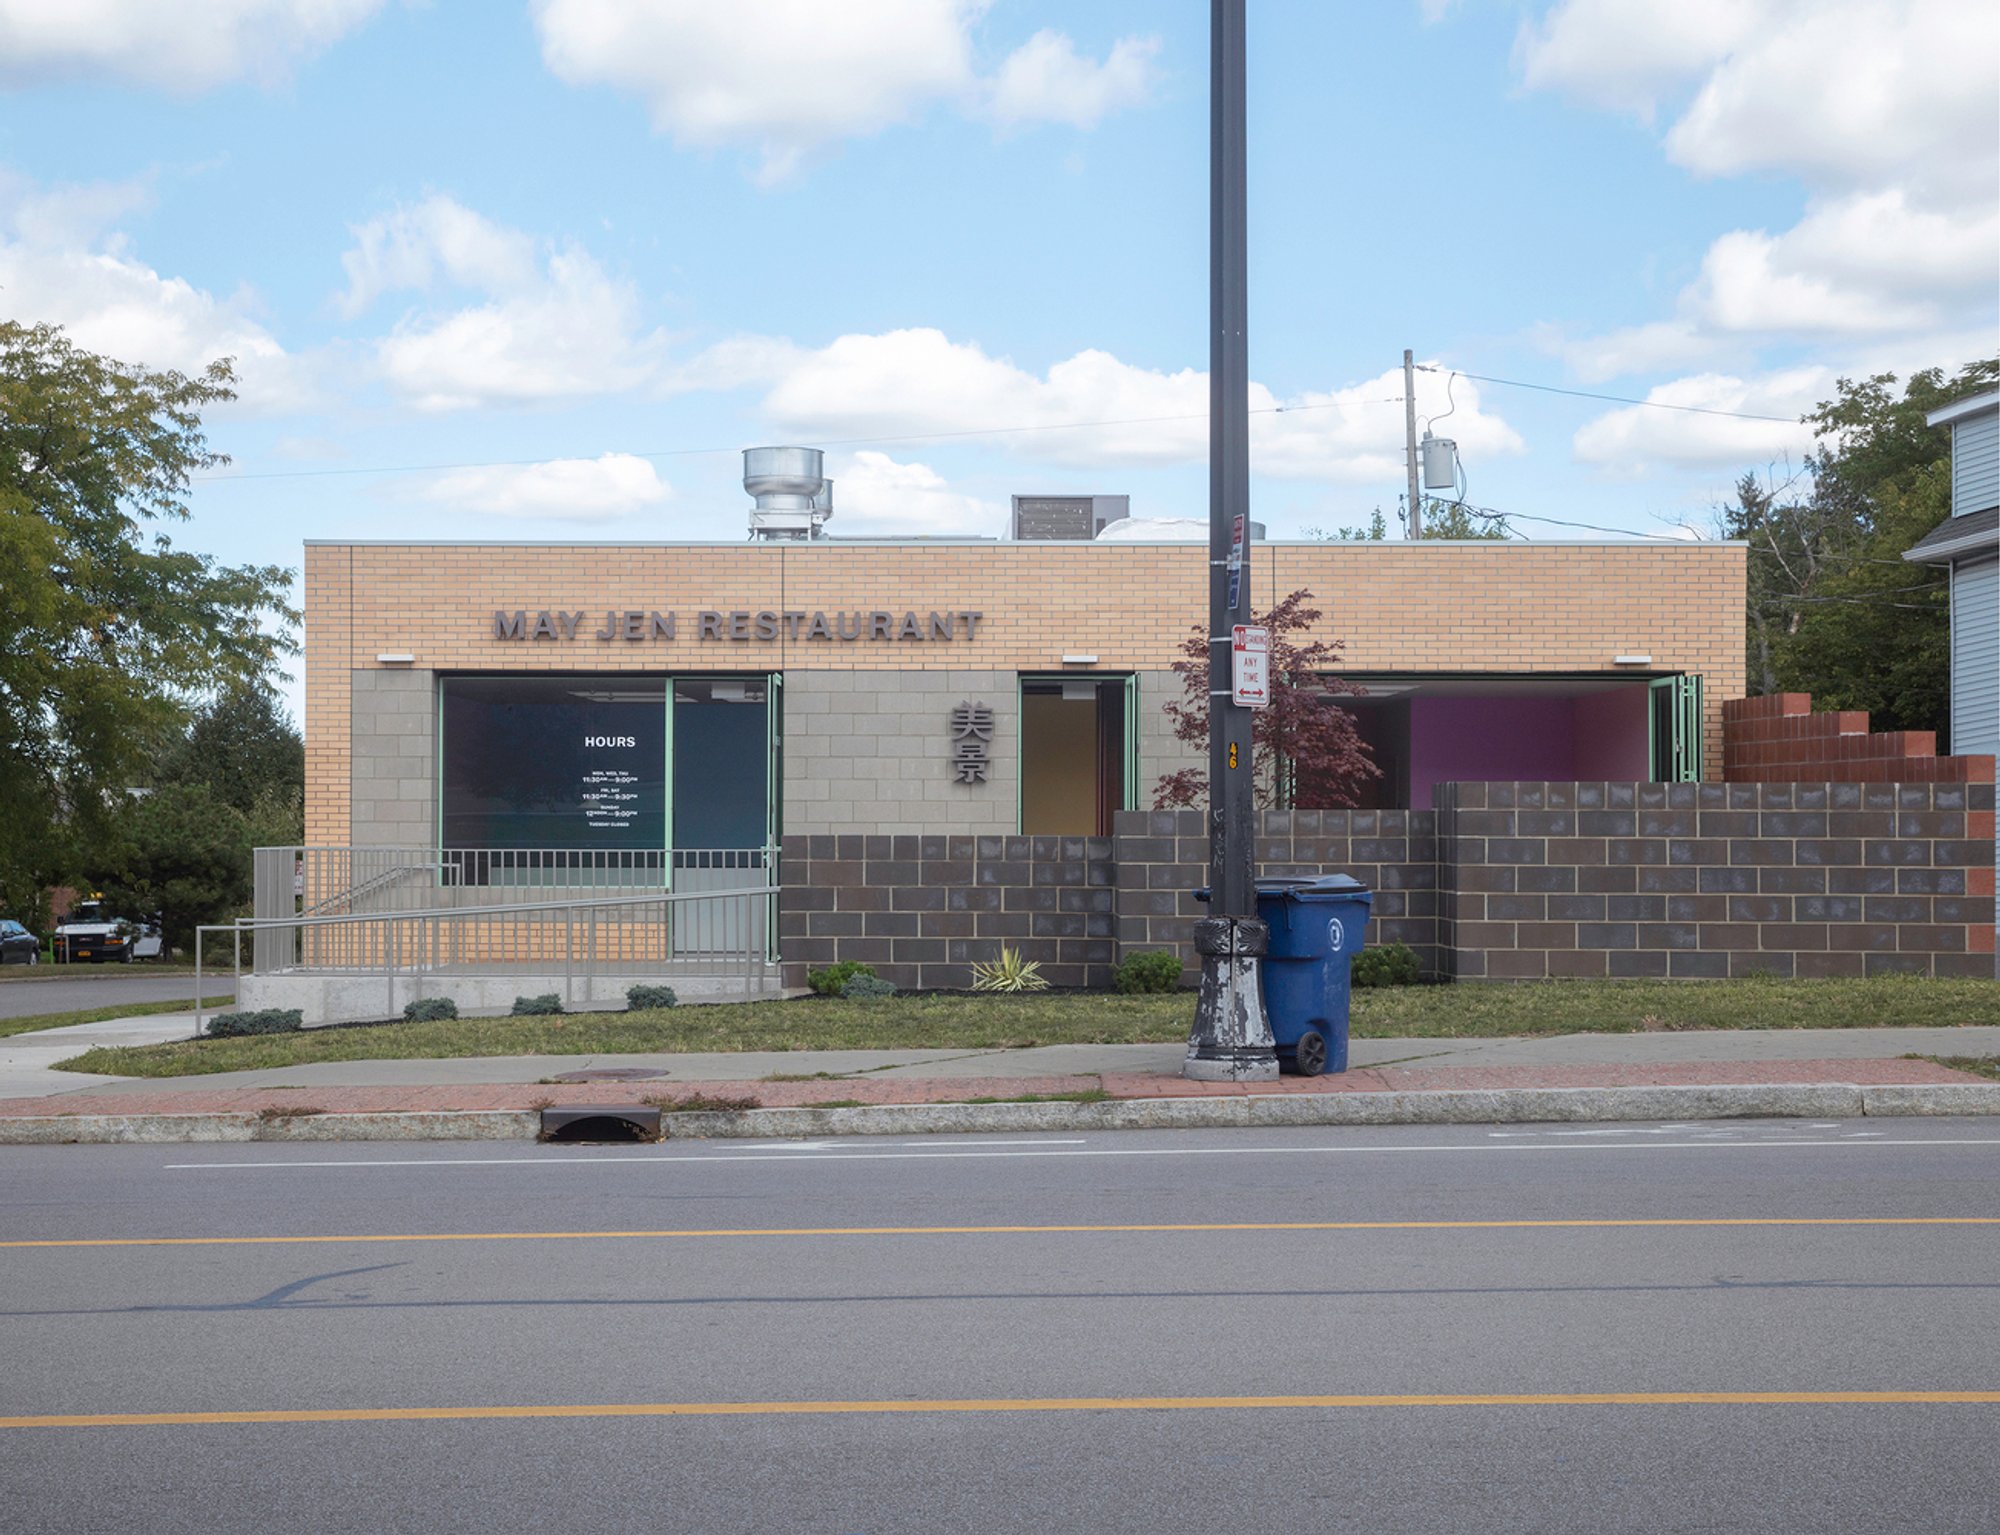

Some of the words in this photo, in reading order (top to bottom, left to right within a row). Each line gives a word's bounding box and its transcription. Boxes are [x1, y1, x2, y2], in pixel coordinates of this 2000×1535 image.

[494, 611, 583, 641] MAY
[597, 611, 675, 641] JEN
[698, 611, 984, 642] RESTAURANT
[1234, 630, 1246, 645] NO
[1244, 657, 1258, 667] ANY
[1243, 672, 1258, 683] TIME
[584, 736, 636, 748] HOURS
[951, 699, 993, 784] 美景
